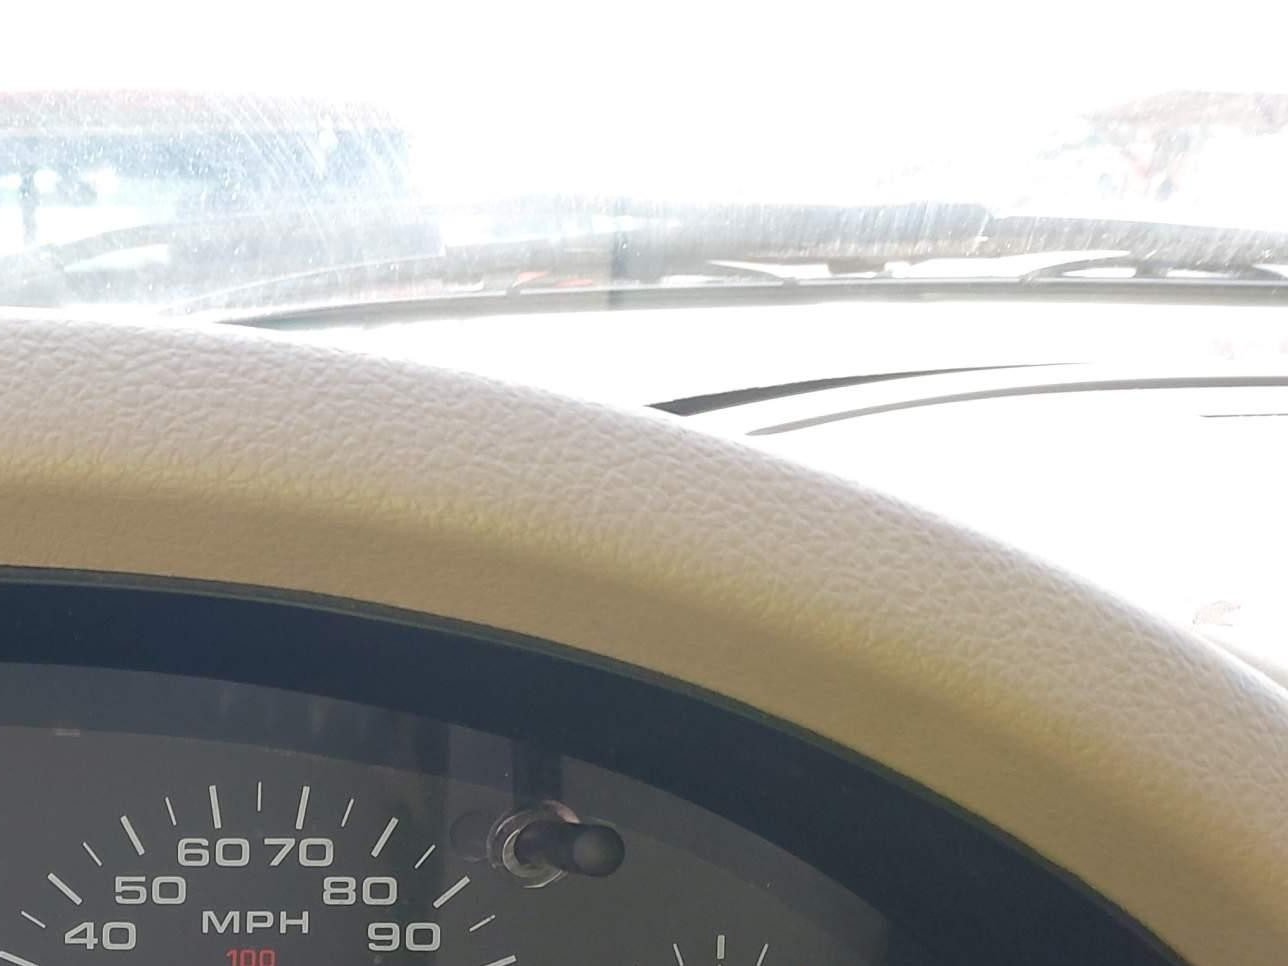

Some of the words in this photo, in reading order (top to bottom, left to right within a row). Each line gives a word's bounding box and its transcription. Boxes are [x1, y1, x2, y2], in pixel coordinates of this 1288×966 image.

[176, 837, 250, 867] 60
[263, 837, 335, 868] 70
[114, 876, 187, 905] 50
[322, 876, 398, 906] 80
[64, 921, 137, 951] 40
[201, 910, 310, 934] MPH
[367, 922, 442, 952] 90
